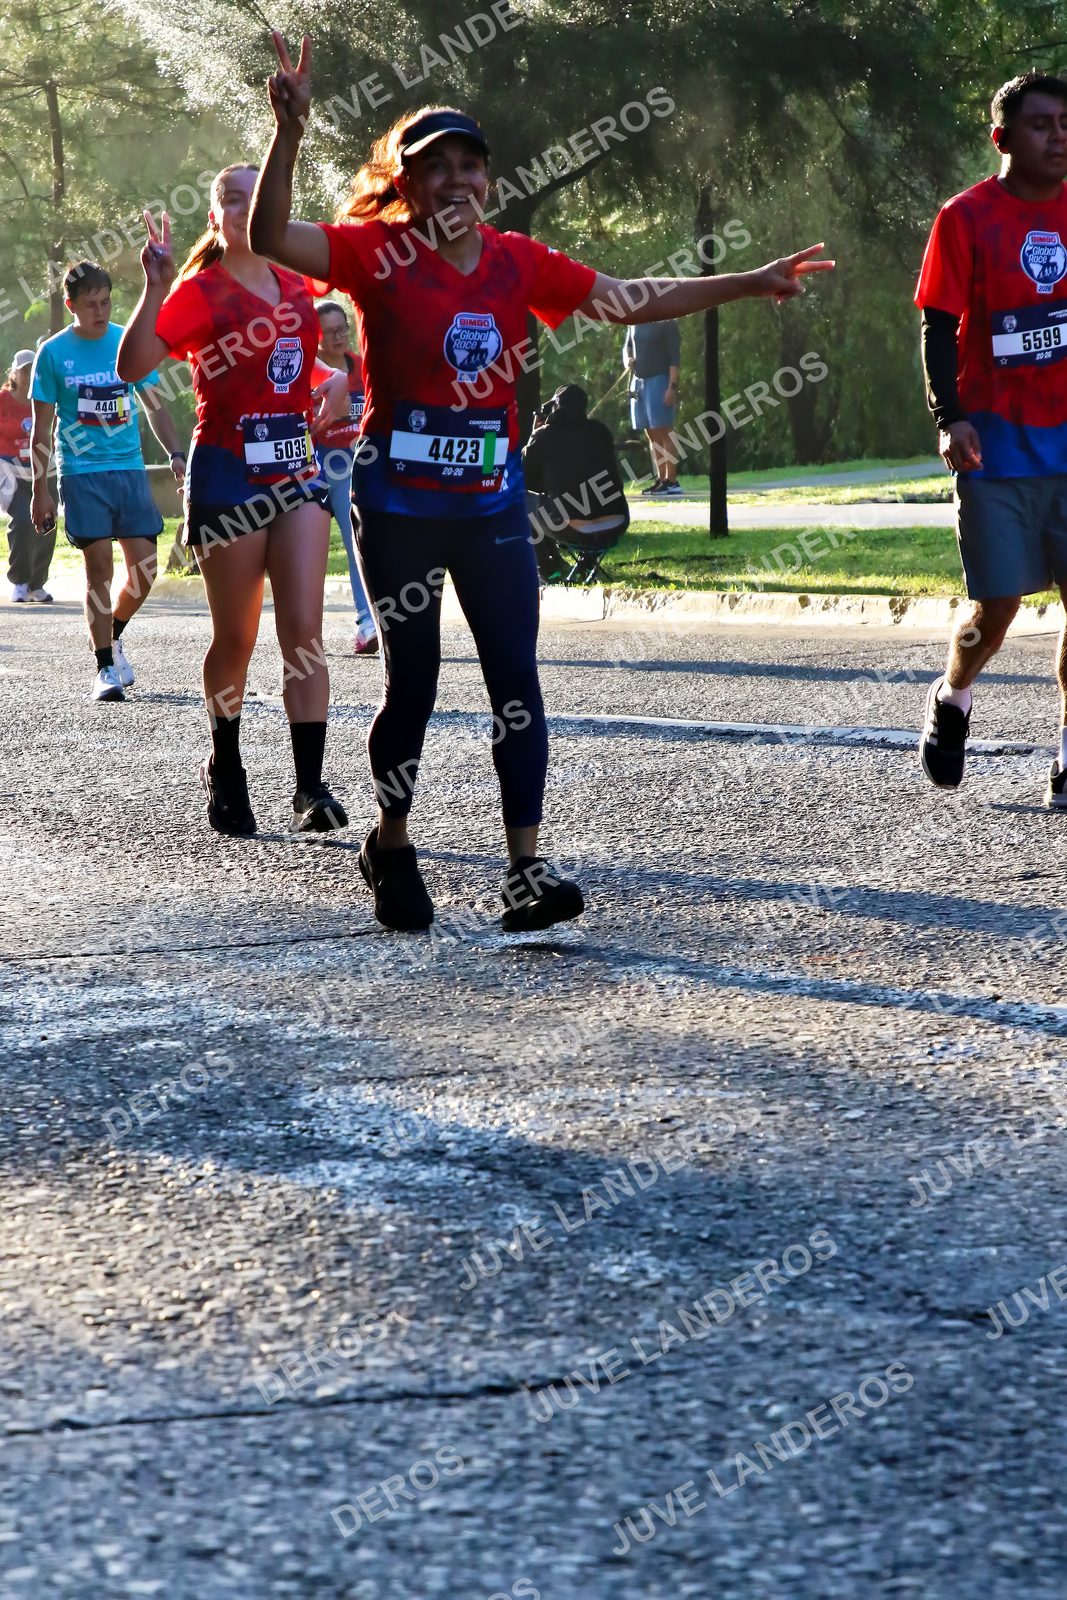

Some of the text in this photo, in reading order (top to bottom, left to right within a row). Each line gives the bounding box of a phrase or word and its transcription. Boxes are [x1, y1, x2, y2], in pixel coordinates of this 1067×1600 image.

[1032, 246, 1057, 256] Global
[1028, 254, 1048, 264] Race
[460, 318, 490, 327] BIMBO
[460, 330, 489, 341] Global
[1022, 326, 1062, 352] 5599
[452, 338, 478, 349] Race
[278, 350, 296, 360] Global
[95, 400, 117, 412] 4441
[274, 436, 307, 460] 5035
[428, 438, 480, 463] 4423
[482, 479, 495, 487] 10K
